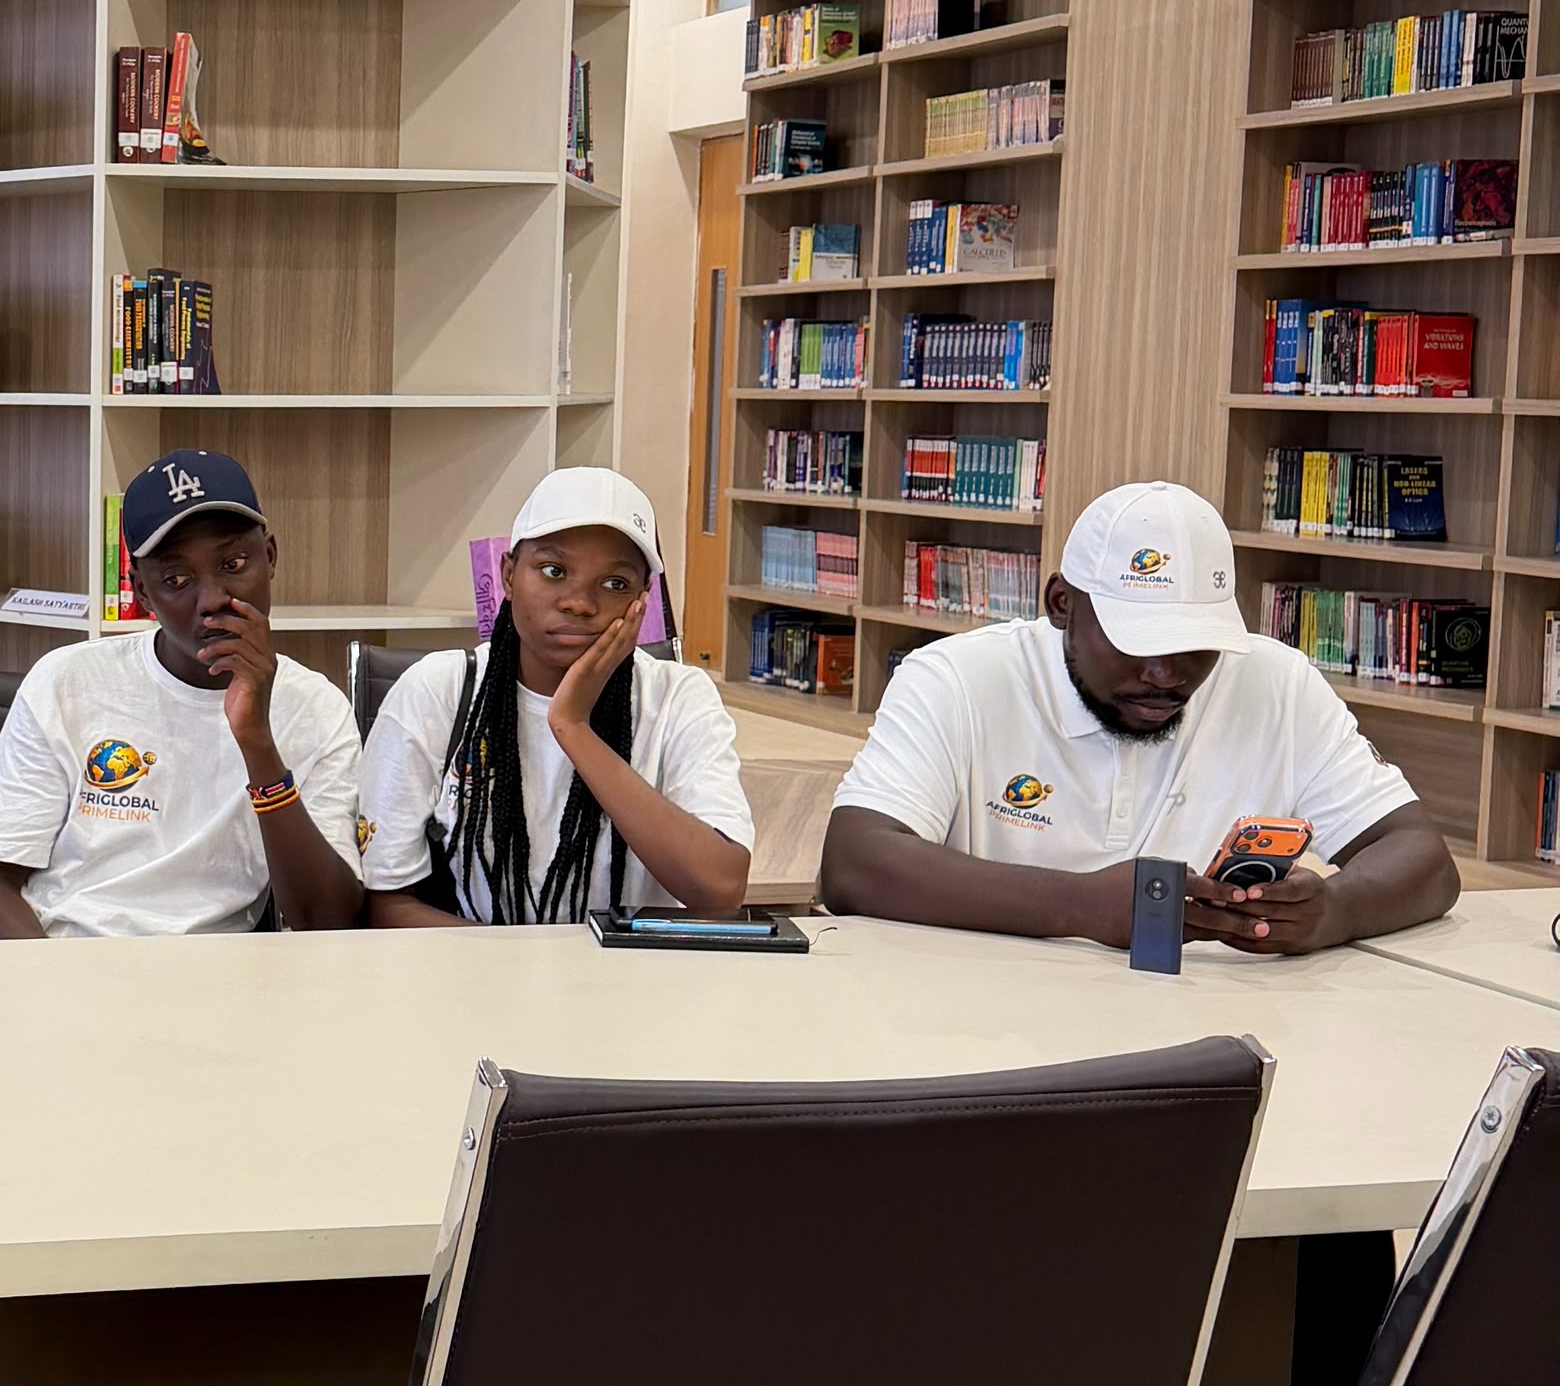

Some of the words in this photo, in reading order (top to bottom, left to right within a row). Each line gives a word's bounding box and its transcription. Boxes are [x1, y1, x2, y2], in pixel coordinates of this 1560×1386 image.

[1423, 341, 1439, 350] AND
[1439, 342, 1465, 351] WAVES
[162, 463, 205, 503] LA
[1120, 574, 1175, 584] AFRIGLOBAL
[985, 800, 1053, 826] AFRIGLOBAL
[987, 810, 1046, 832] PRIMELINK
